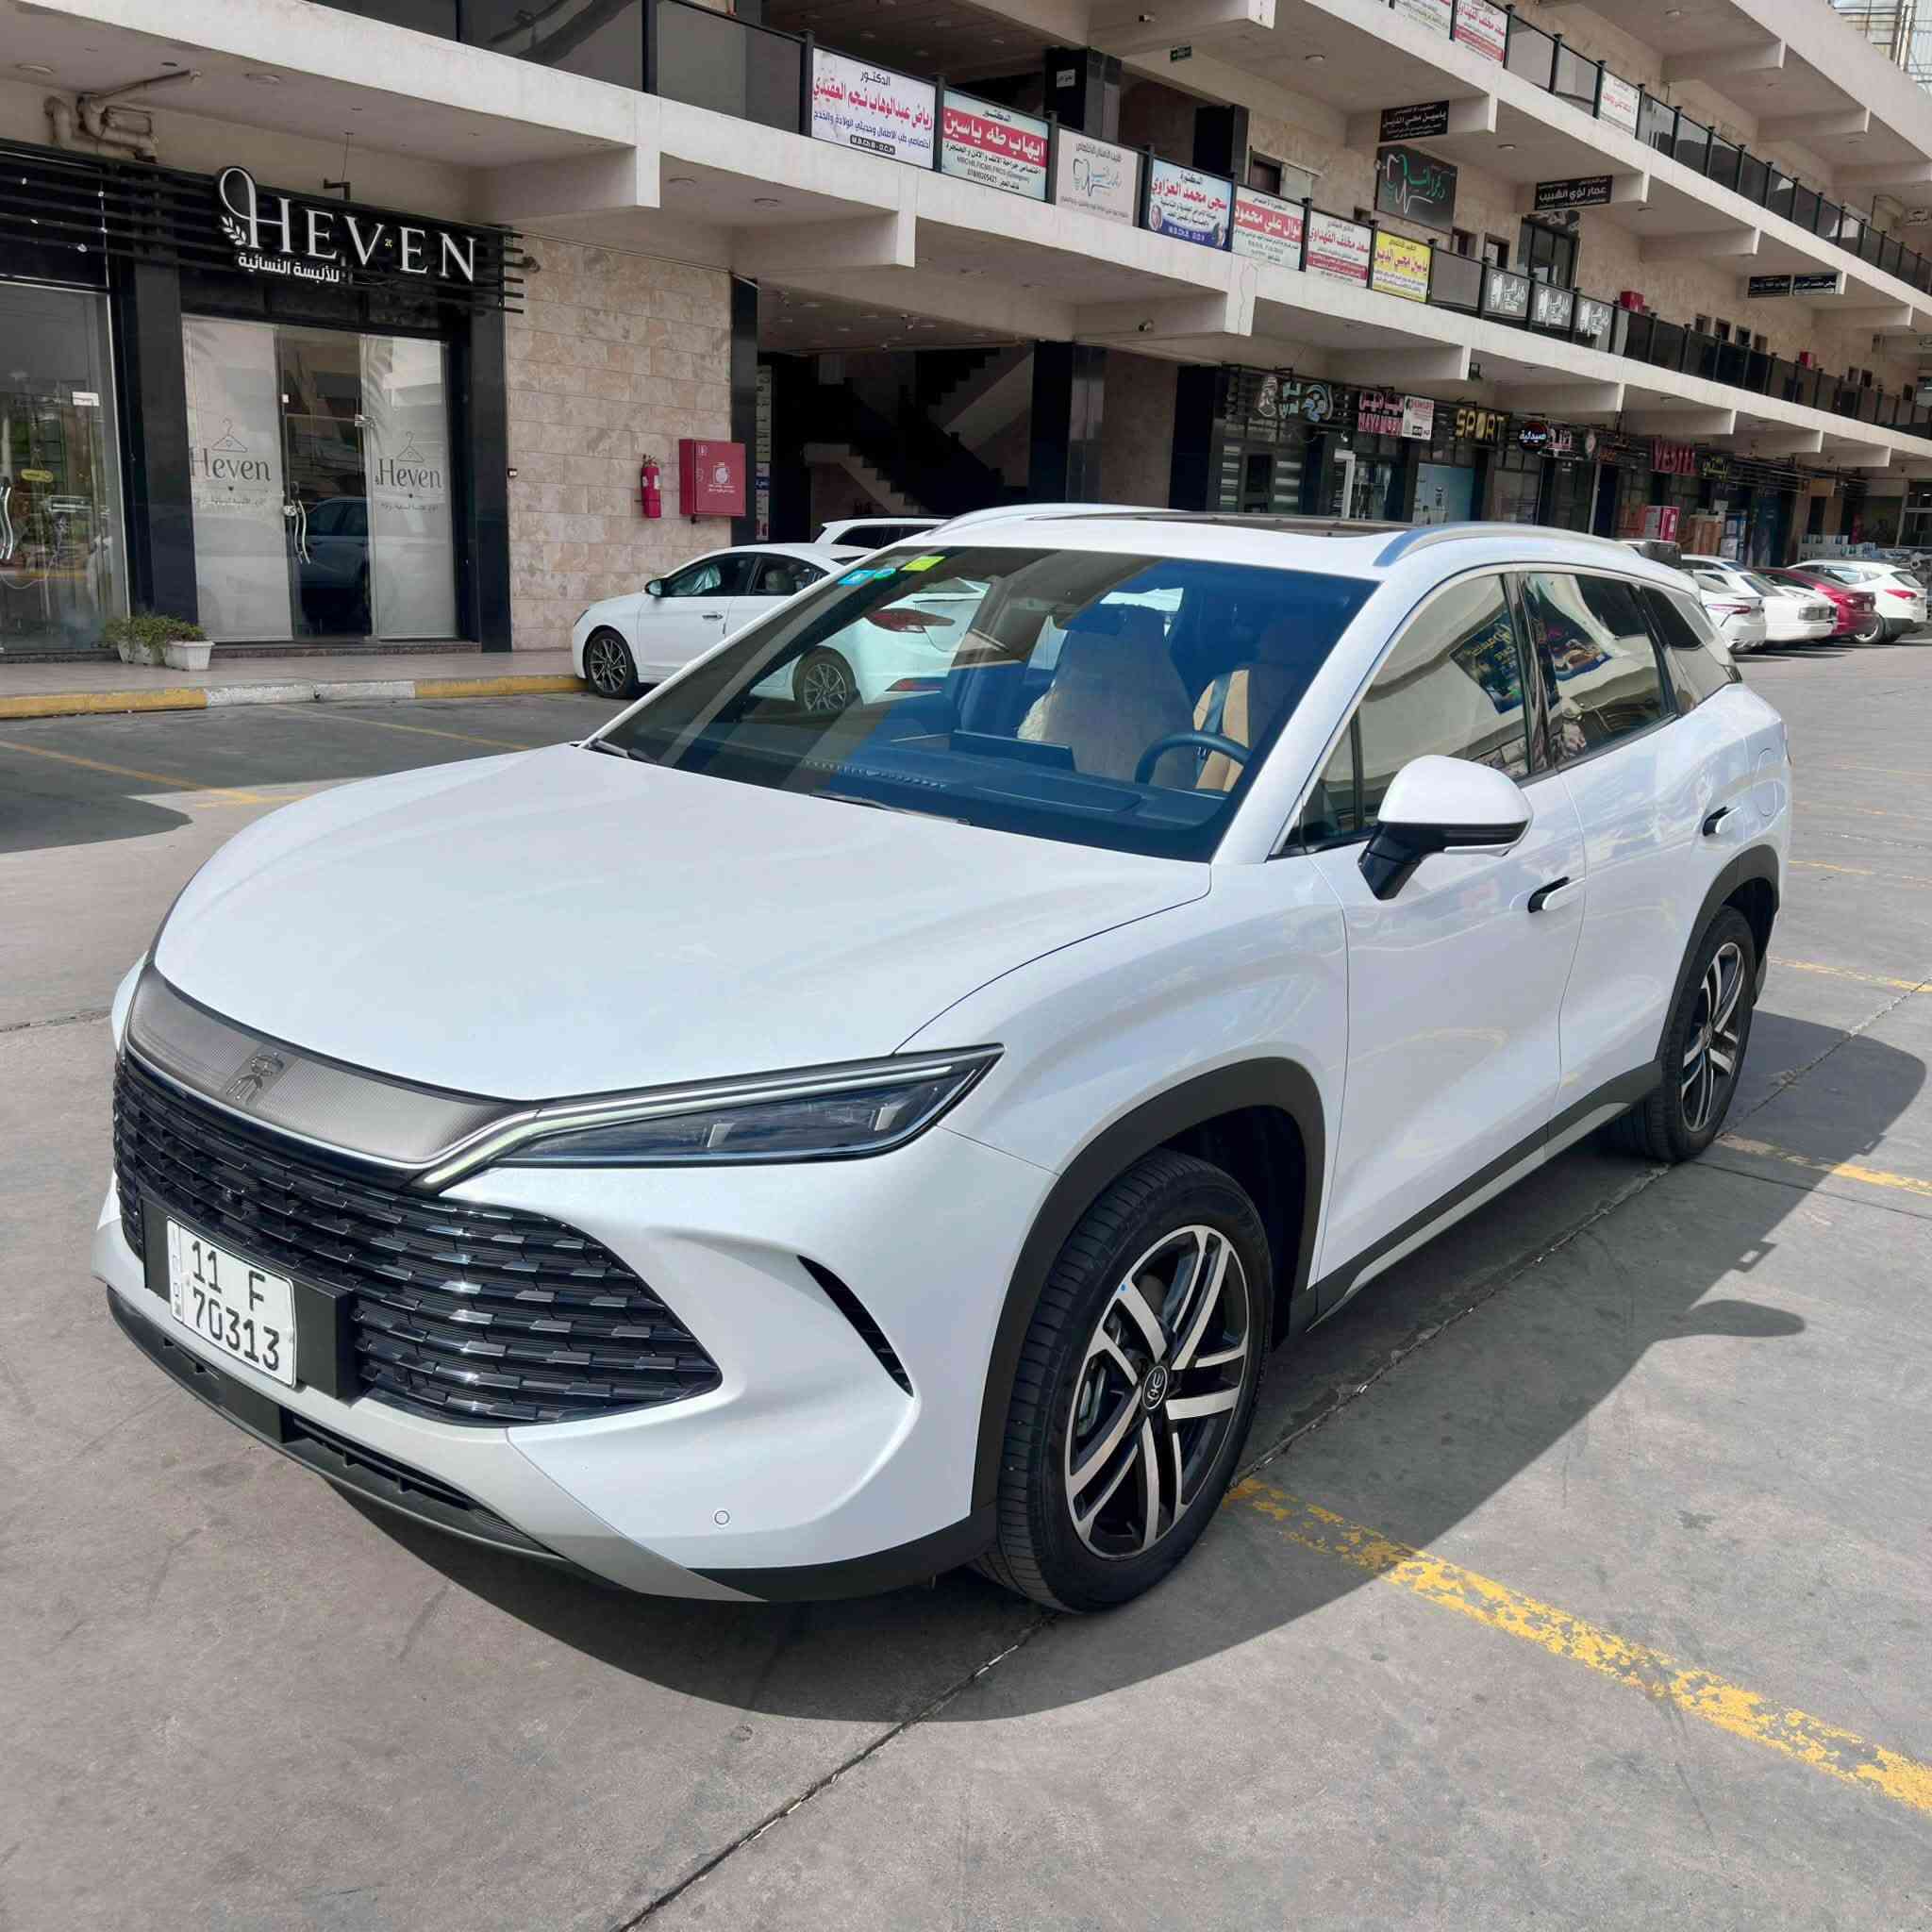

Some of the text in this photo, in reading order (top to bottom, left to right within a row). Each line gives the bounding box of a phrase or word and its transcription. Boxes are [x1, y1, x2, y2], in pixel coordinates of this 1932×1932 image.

[943, 111, 982, 144] ياسين
[987, 125, 1007, 145] طه
[220, 167, 477, 282] HEVEN
[238, 252, 341, 283] للألبسة النسائية
[188, 447, 272, 482] Heven
[377, 458, 442, 489] Heven
[192, 1240, 223, 1294] 11
[248, 1270, 266, 1312] F
[192, 1286, 280, 1373] 70313
